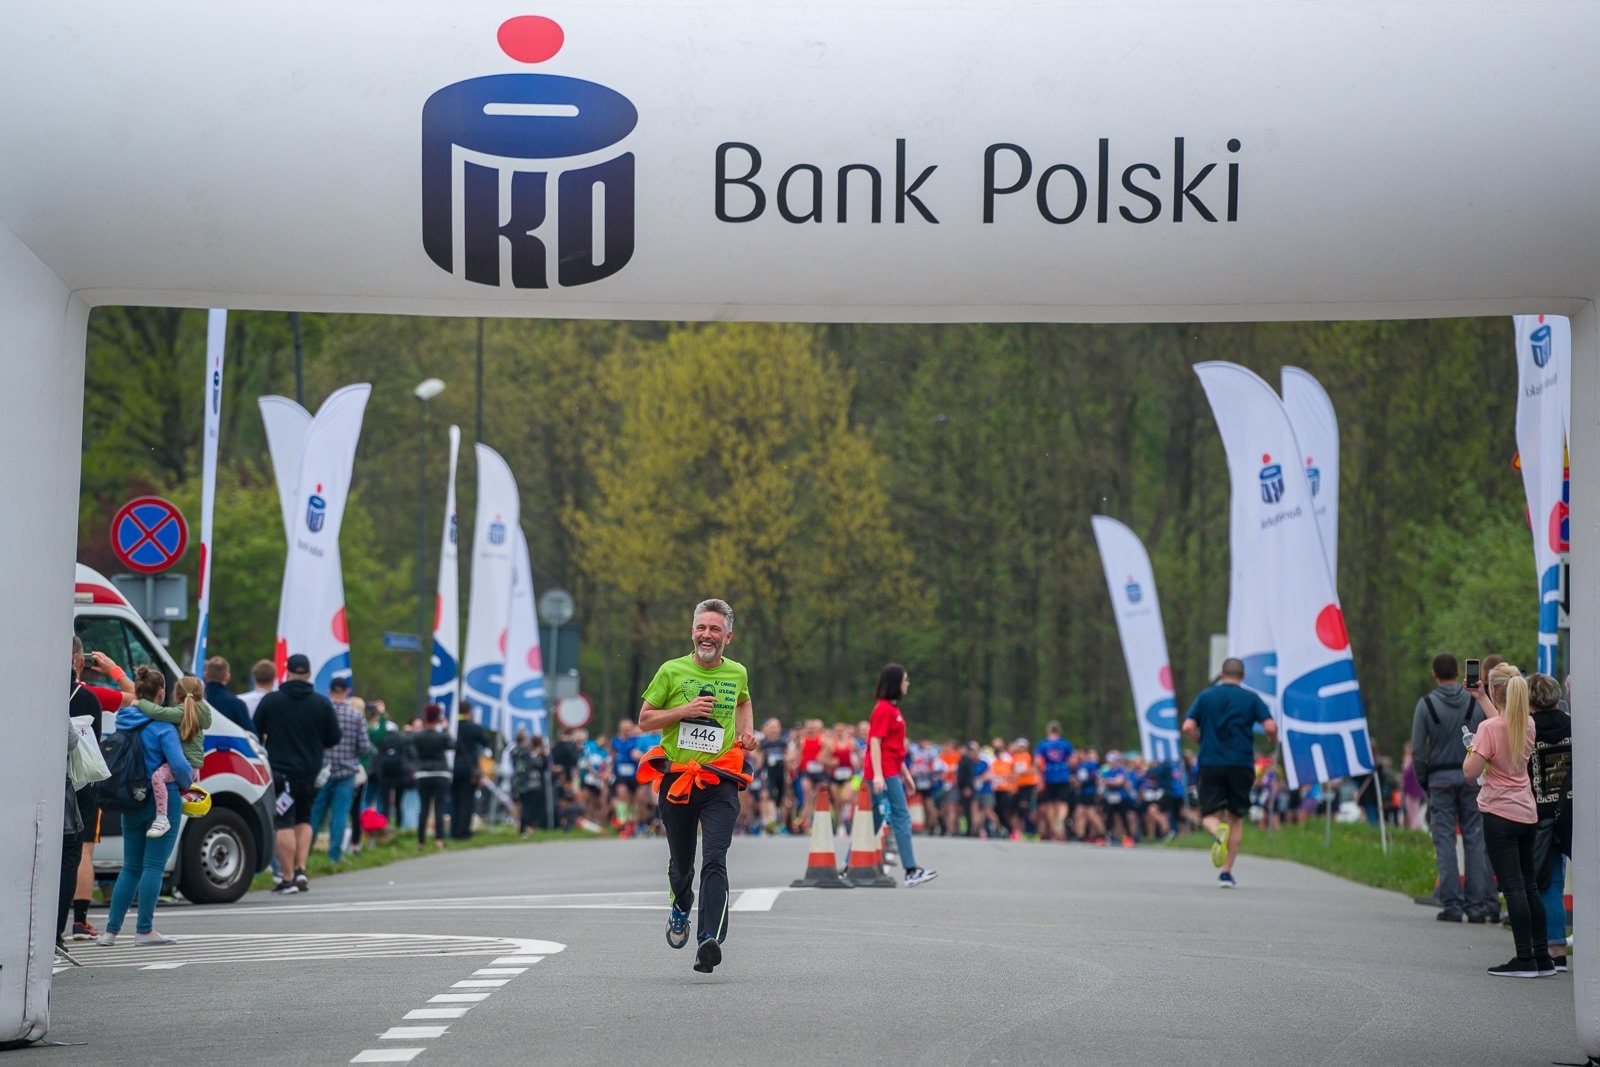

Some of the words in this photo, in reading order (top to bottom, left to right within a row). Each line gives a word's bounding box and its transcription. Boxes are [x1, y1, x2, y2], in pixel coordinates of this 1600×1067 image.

[422, 73, 638, 289] PKO
[715, 138, 940, 224] Bank
[982, 136, 1242, 225] Polski
[690, 727, 716, 742] 446
